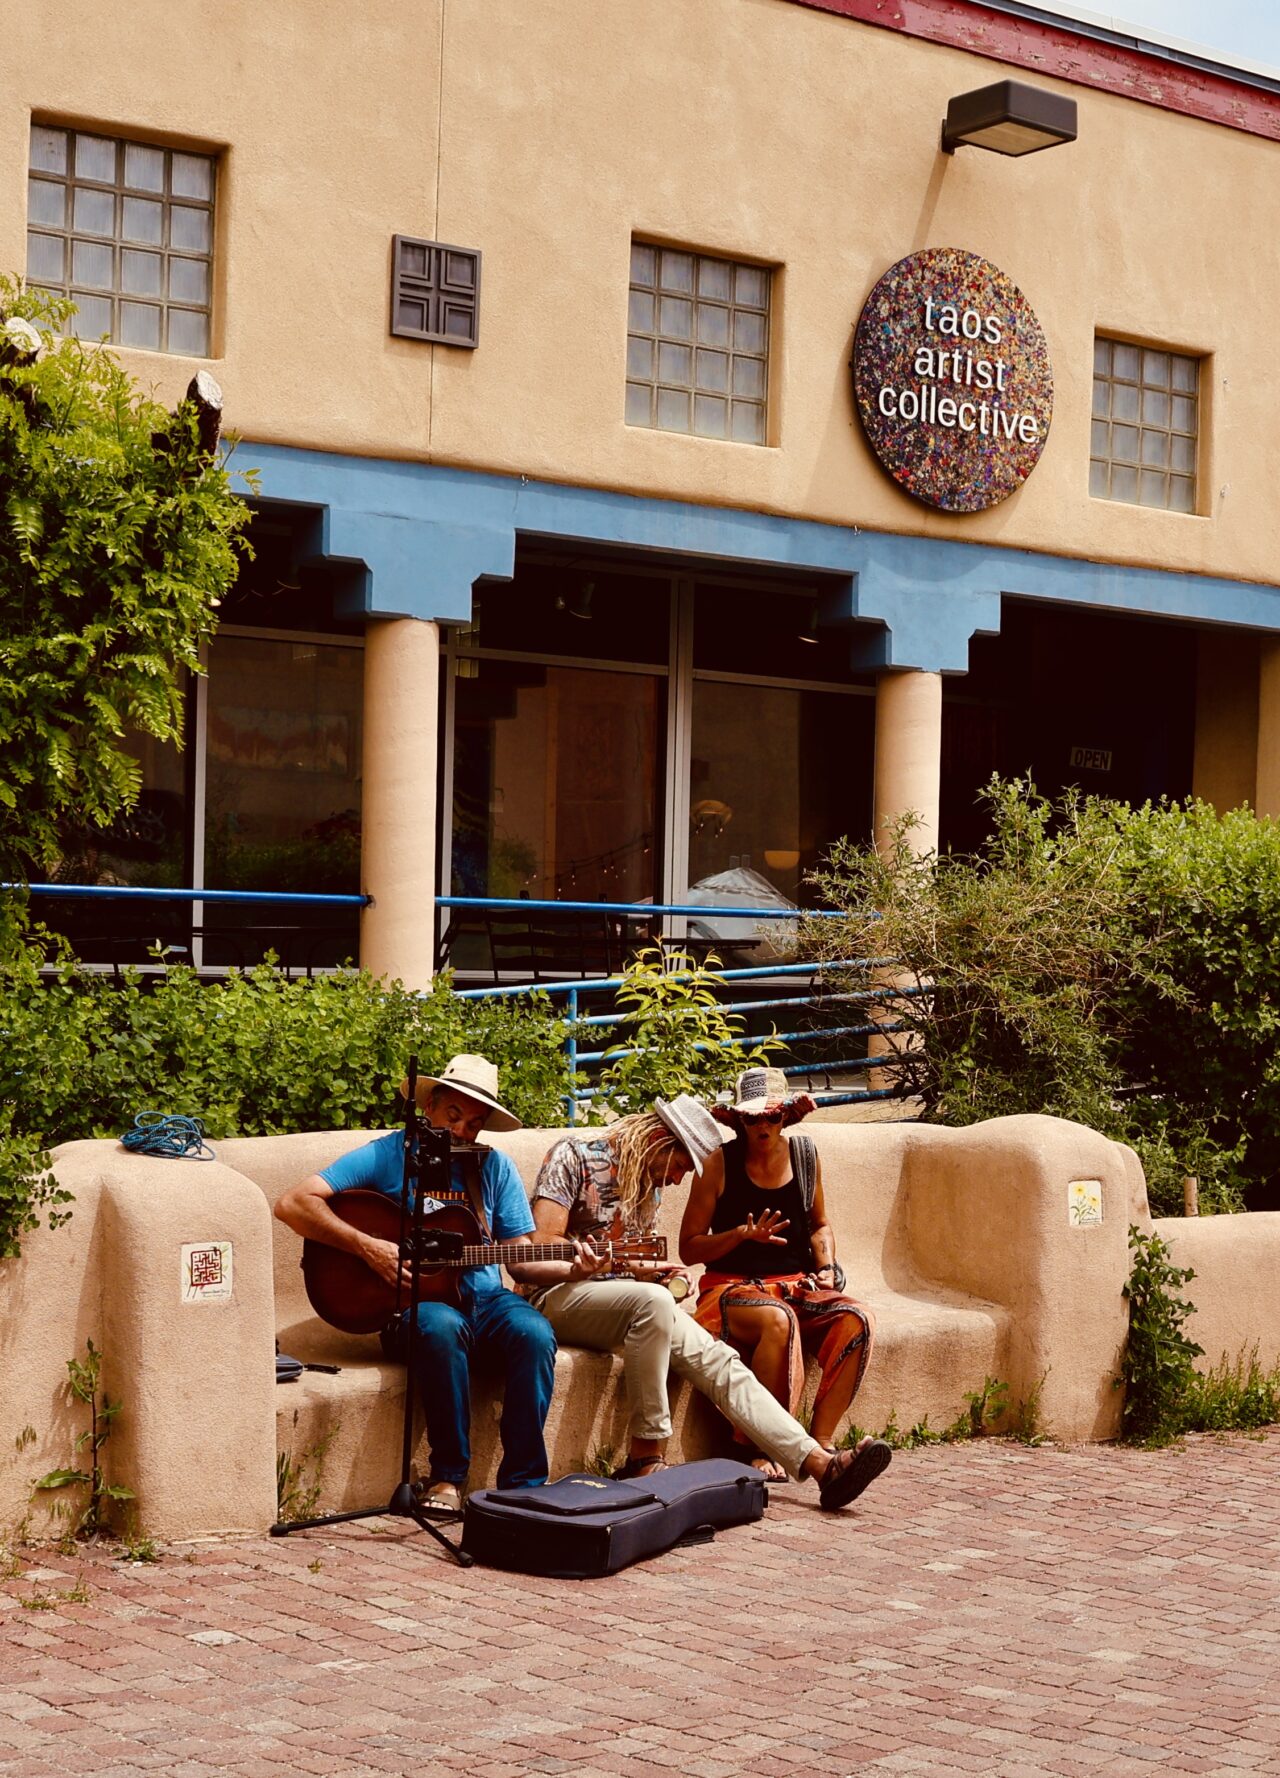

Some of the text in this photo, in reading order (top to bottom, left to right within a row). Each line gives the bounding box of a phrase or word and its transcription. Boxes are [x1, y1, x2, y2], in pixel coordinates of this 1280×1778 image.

[925, 296, 1002, 344] taos
[914, 347, 1006, 392] artist
[878, 385, 1039, 443] collective
[1074, 750, 1109, 769] OPEN
